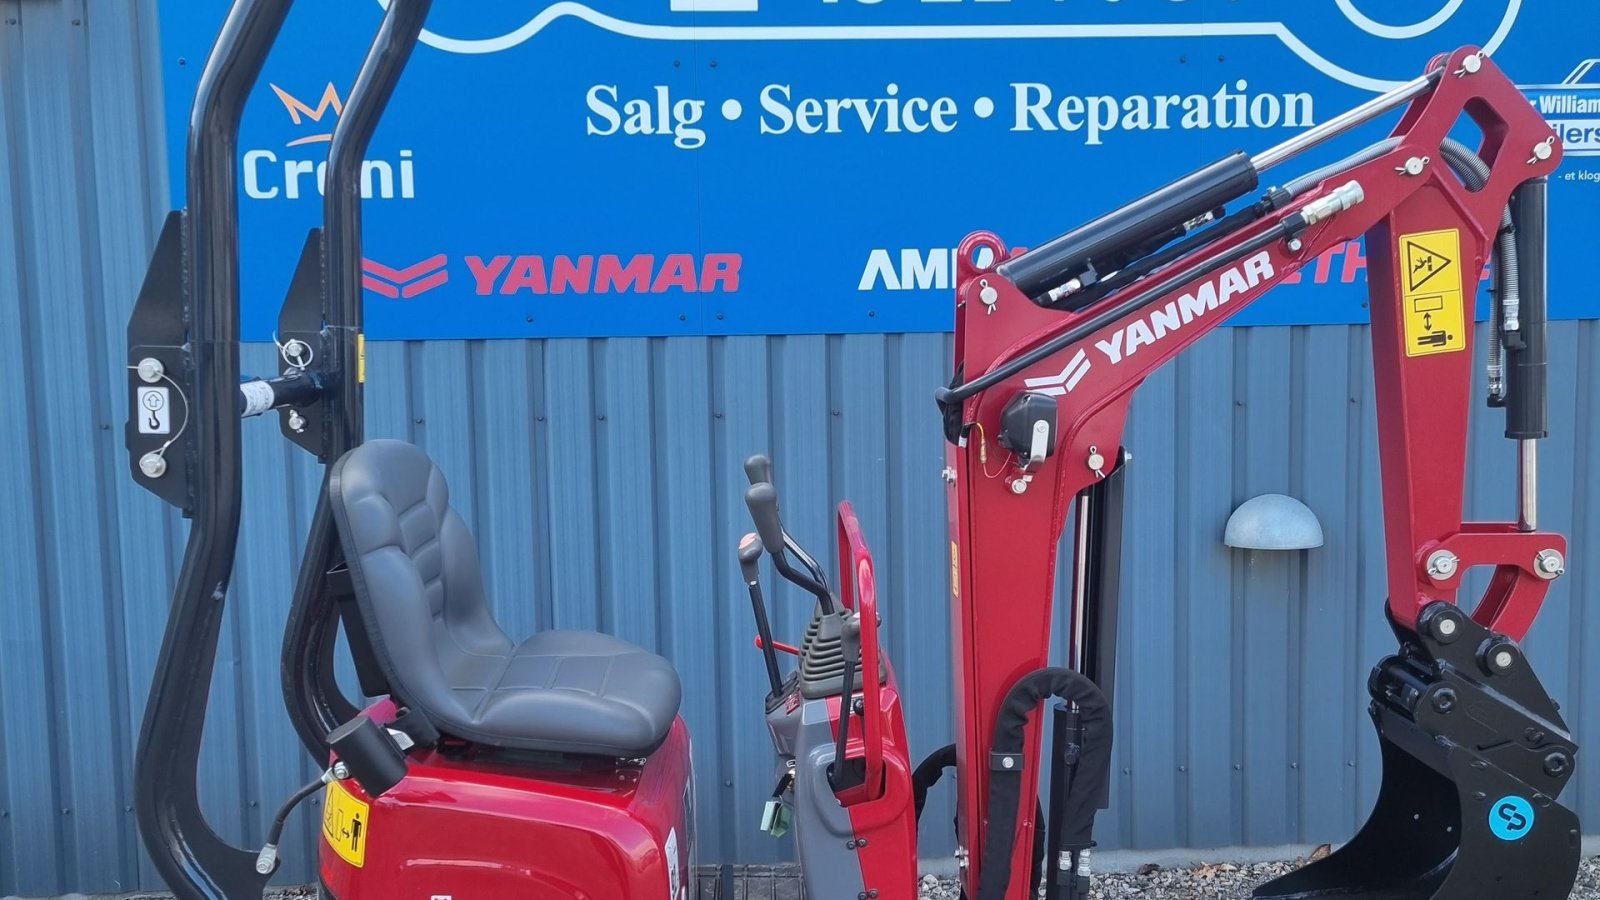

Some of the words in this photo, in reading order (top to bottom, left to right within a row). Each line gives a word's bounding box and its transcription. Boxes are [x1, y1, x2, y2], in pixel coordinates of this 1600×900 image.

[586, 84, 707, 149] Salg
[759, 83, 958, 135] Service
[1009, 79, 1316, 145] Reparation
[1565, 171, 1575, 180] et
[464, 253, 743, 296] YANMAR
[1094, 250, 1275, 365] YANMAR
